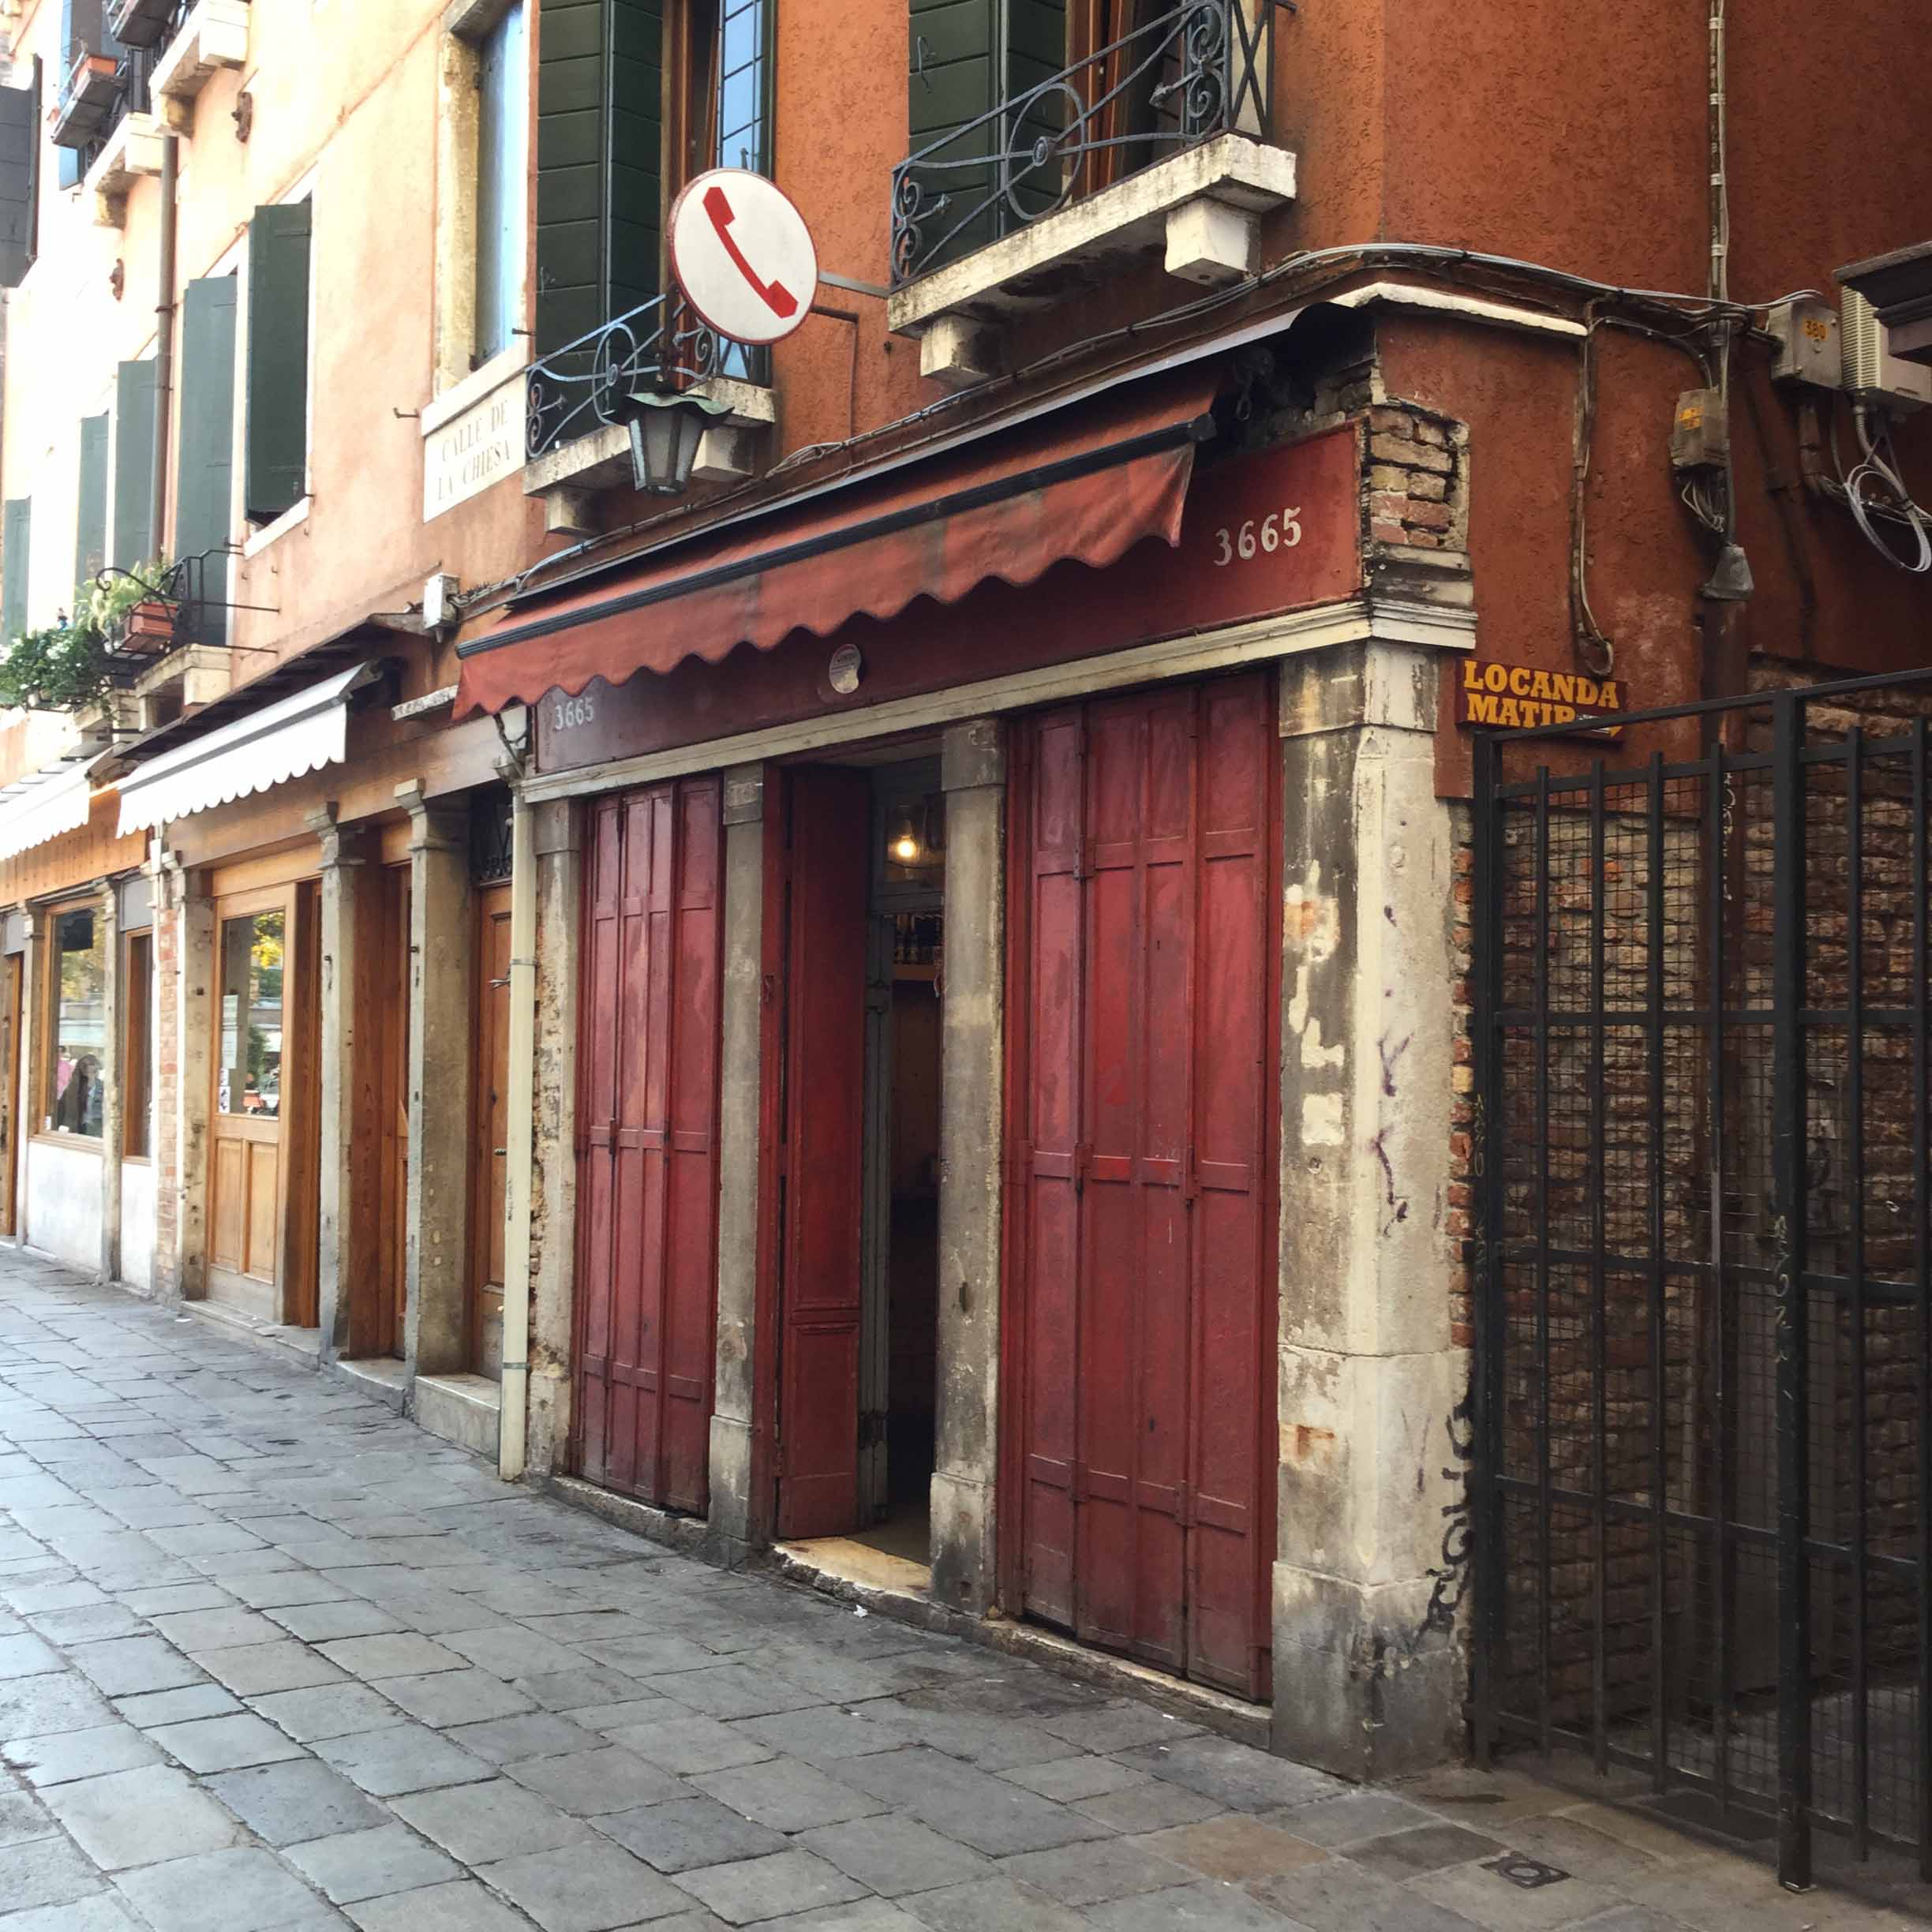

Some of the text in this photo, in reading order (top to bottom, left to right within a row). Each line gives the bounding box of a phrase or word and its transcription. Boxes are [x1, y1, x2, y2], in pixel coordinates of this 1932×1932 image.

[441, 399, 508, 462] CALLE DE
[438, 439, 511, 501] LA CHIESA
[1213, 506, 1302, 567] 3665
[555, 696, 594, 731] 3665
[1463, 660, 1619, 709] LOCANDA
